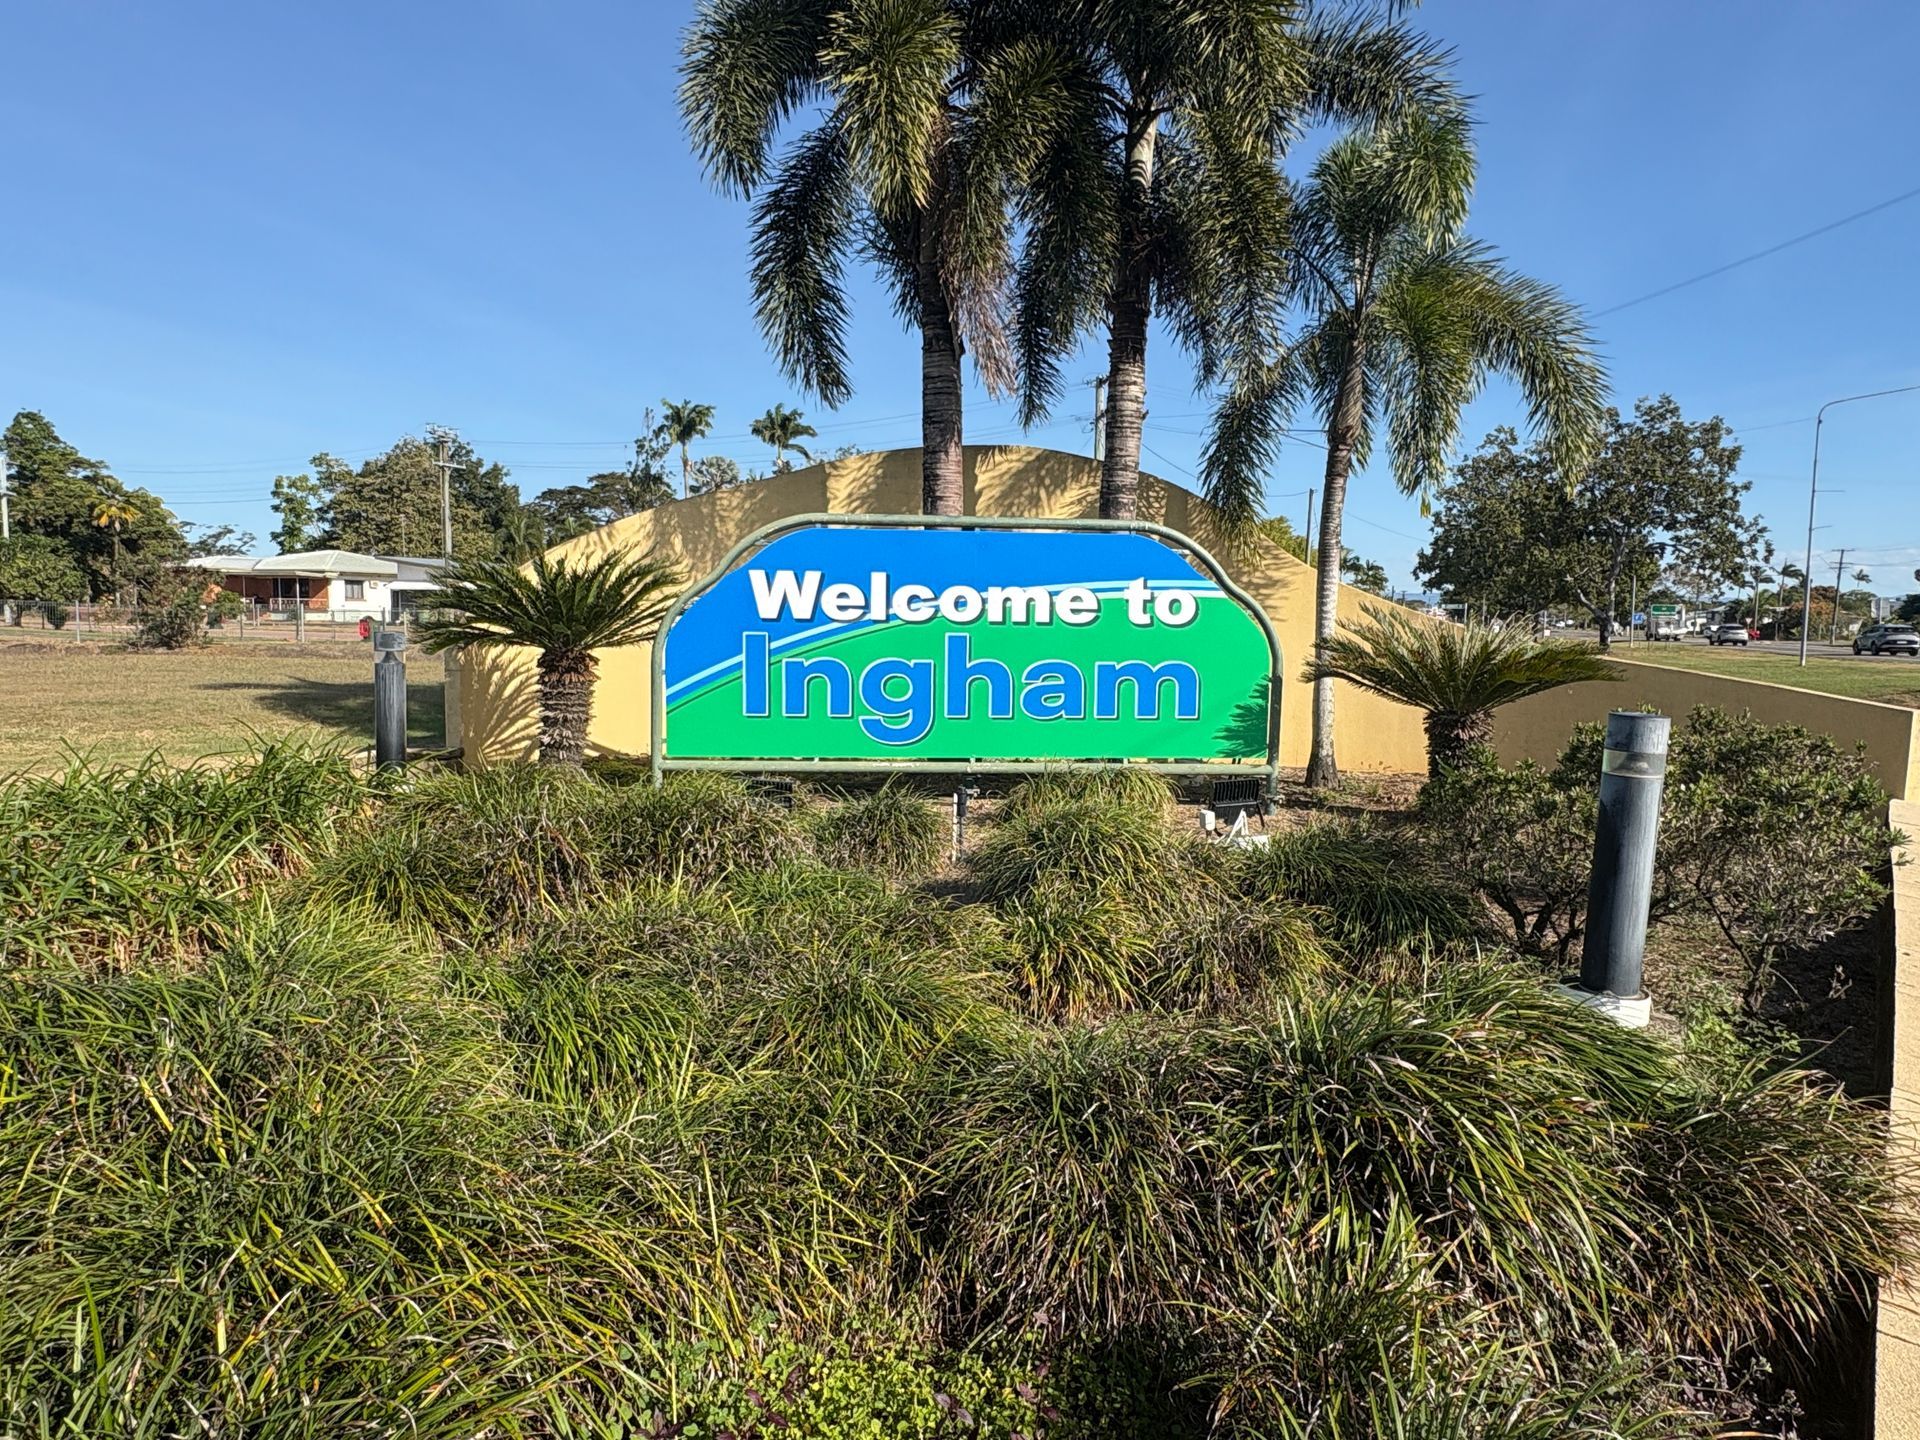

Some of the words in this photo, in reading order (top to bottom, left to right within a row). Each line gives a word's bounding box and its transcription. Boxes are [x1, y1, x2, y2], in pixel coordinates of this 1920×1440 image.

[748, 569, 1100, 626] Welcome
[1126, 577, 1198, 627] to
[742, 631, 1201, 745] Ingham
